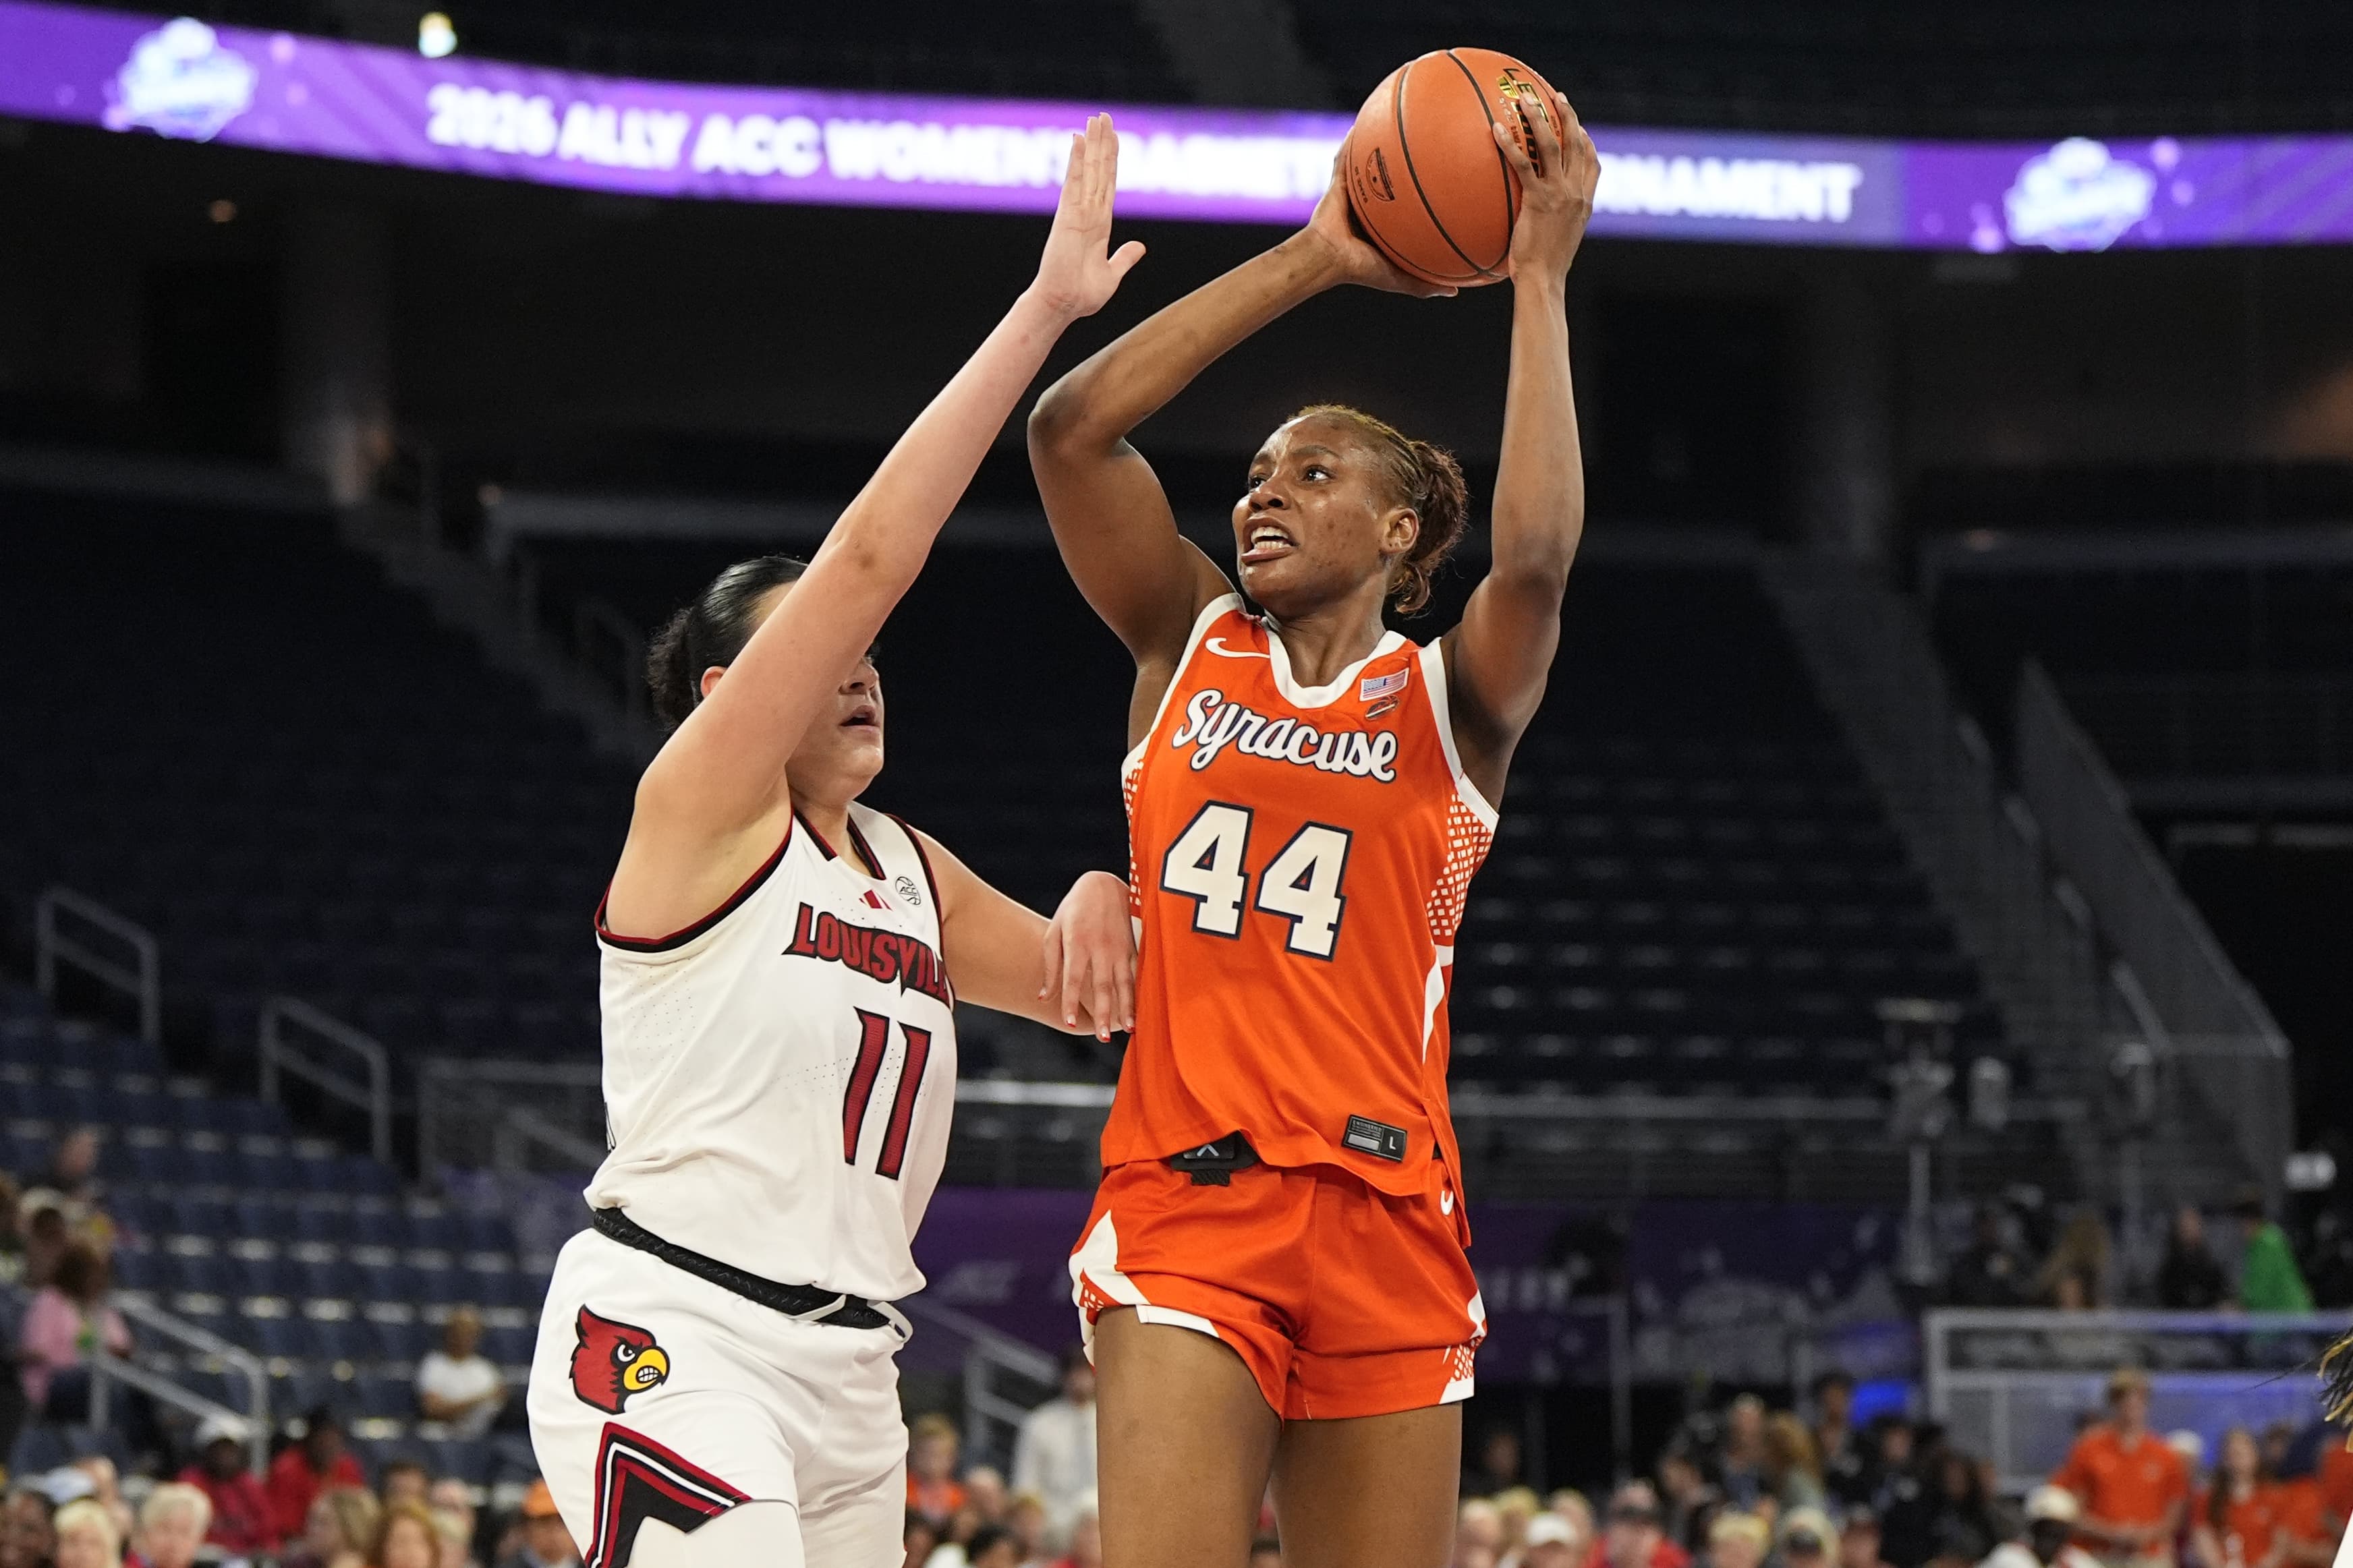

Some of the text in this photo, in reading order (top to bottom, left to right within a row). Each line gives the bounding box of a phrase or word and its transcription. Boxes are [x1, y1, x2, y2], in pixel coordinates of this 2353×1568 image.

[427, 82, 558, 156] 2026
[559, 100, 689, 170] ALLY
[691, 113, 823, 178] ACC
[1172, 689, 1398, 784] Syracuse
[1159, 800, 1353, 962] 44
[781, 902, 951, 1009] LOUISVILL
[843, 1006, 932, 1181] 11
[1389, 1136, 1396, 1150] L
